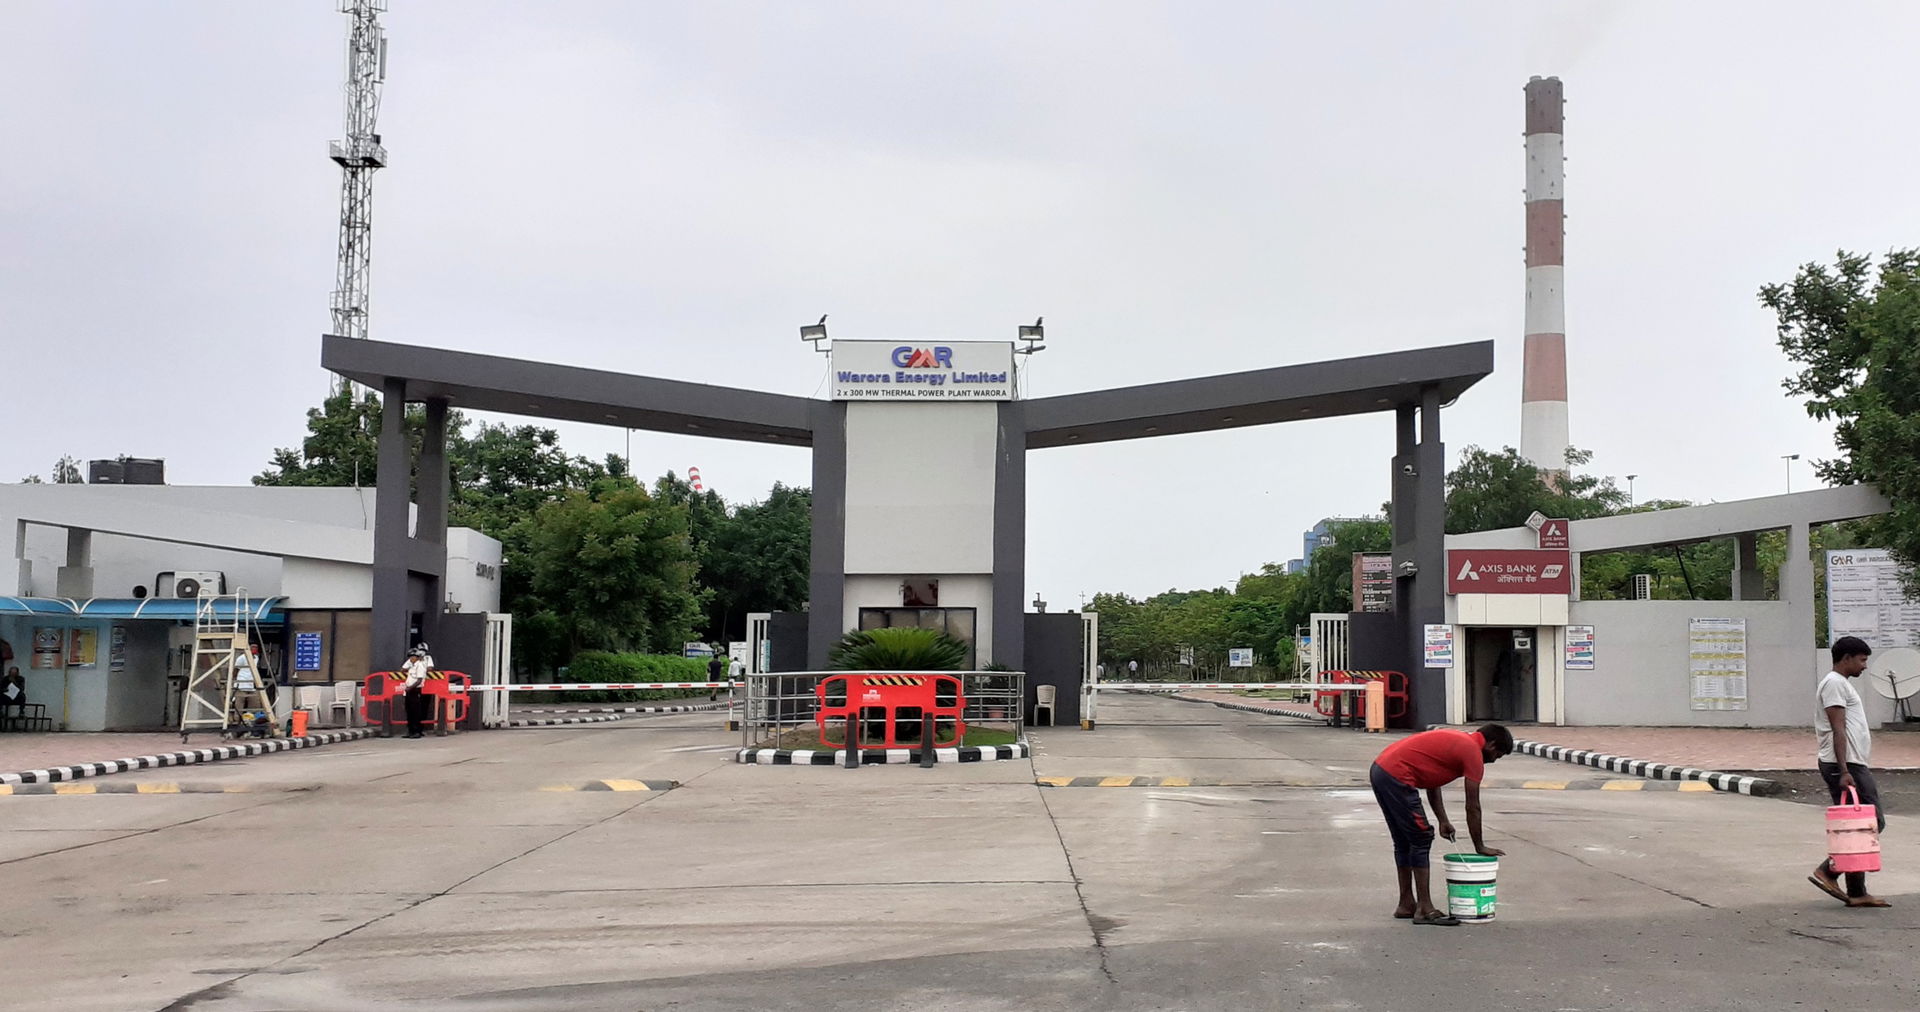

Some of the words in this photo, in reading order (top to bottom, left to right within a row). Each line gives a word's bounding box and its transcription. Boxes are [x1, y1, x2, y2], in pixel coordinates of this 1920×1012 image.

[891, 346, 953, 368] GMR
[837, 371, 891, 383] Warora
[895, 371, 947, 386] Energy
[952, 371, 1007, 383] Limited
[948, 389, 972, 397] PLANT
[973, 389, 1007, 397] WARORA
[1830, 555, 1854, 566] GMR
[1479, 564, 1504, 573] AXIS
[1506, 564, 1537, 573] BANK
